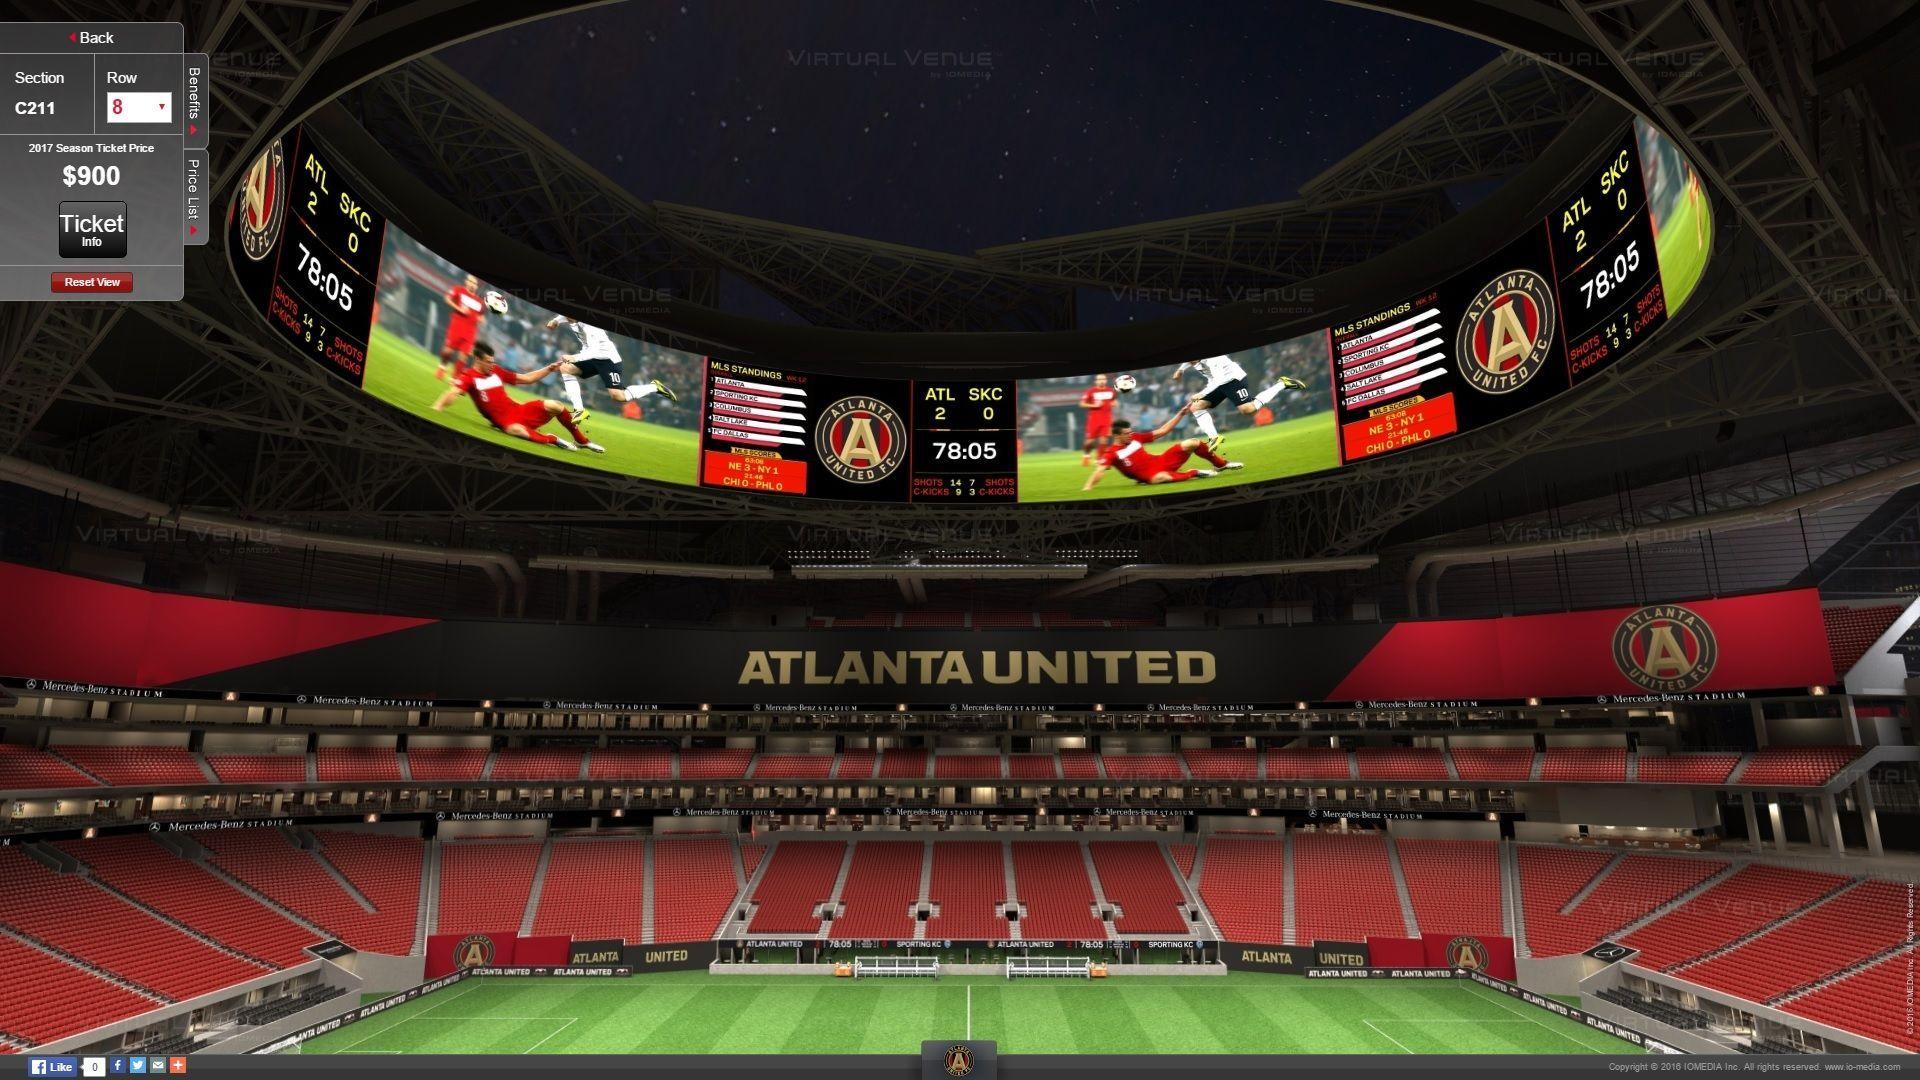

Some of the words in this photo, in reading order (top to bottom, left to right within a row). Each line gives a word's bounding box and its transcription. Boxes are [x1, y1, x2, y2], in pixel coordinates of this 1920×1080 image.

[305, 153, 328, 195] ATL
[339, 192, 372, 233] SKC
[1562, 197, 1592, 234] ATL
[1600, 150, 1630, 195] SKC
[308, 192, 318, 216] 2
[348, 232, 358, 253] 0
[1575, 230, 1587, 252] 2
[1618, 188, 1628, 211] 0
[298, 242, 354, 312] 78:05
[1580, 240, 1640, 309] 78:05
[1468, 275, 1534, 322] ATLANTA
[274, 285, 298, 315] SHOTS
[303, 313, 314, 328] 14
[334, 336, 364, 362] SHOTS
[1334, 324, 1354, 336] MLS
[1356, 302, 1411, 330] STANDINGS
[1570, 335, 1600, 362] SHOTS
[1606, 323, 1617, 338] 14
[1637, 284, 1661, 314] SHOTS
[272, 301, 301, 335] C-KICKS
[326, 346, 361, 375] C-KICKS
[1342, 335, 1373, 350] ATLANTA
[1572, 344, 1608, 374] C-KICKS
[1634, 300, 1664, 334] C-KICKS
[710, 361, 730, 372] MLS
[732, 366, 782, 380] STANDINGS
[1472, 366, 1530, 390] UNITED
[1531, 339, 1548, 364] FC
[608, 372, 620, 382] 10
[925, 388, 956, 401] ATL
[968, 387, 1002, 401] SKC
[1236, 388, 1249, 398] 10
[830, 400, 894, 422] ATLANTA
[934, 407, 946, 420] 2
[982, 407, 994, 420] 0
[1368, 425, 1384, 436] NE
[1400, 416, 1416, 426] NY
[932, 442, 997, 460] 78:05
[1366, 443, 1385, 454] CHI
[1402, 434, 1422, 446] PHL
[728, 462, 742, 471] NE
[758, 466, 772, 474] NY
[824, 456, 876, 480] UNITED
[880, 457, 896, 475] FC
[724, 476, 740, 486] CHI
[756, 480, 774, 490] PHL
[914, 478, 943, 486] SHOTS
[950, 478, 962, 486] 14
[985, 478, 1014, 486] SHOTS
[913, 488, 950, 496] C-KICKS
[978, 488, 1015, 496] C-KICKS
[1624, 606, 1696, 632] ATLANTA
[738, 650, 974, 684] ATLANTA
[982, 650, 1217, 684] UNITED
[1628, 668, 1690, 692] UNITED
[1689, 664, 1710, 683] FC
[42, 680, 108, 694] Mercedes-Benz
[110, 688, 163, 698] STADIUM
[313, 696, 381, 706] Mercedes-Benz
[384, 700, 433, 708] STADIUM
[556, 701, 613, 710] Mercedes-Benz
[1368, 700, 1428, 708] Mercedes-Benz
[1613, 694, 1685, 704] Mercedes-Benz
[1688, 692, 1746, 701] STADIUM
[1158, 703, 1210, 711] Mercedes-Benz
[452, 812, 513, 820] Mercedes-Benz
[686, 808, 739, 816] Mercedes-Benz
[896, 808, 948, 816] Mercedes-Benz
[1106, 808, 1158, 816] Mercedes-Benz
[1322, 810, 1381, 818] Mercedes-Benz
[168, 820, 244, 832] Mercedes-Benz
[247, 818, 293, 828] STADIUM
[746, 940, 776, 948] ATLANTA
[776, 940, 803, 948] UNITED
[829, 940, 852, 948] 78:05
[896, 940, 930, 948] SPORTING
[932, 940, 942, 948] KC
[572, 951, 618, 964] ATLANTA
[646, 950, 688, 964] UNITED
[1242, 950, 1292, 965] ATLANTA
[1320, 952, 1364, 967] UNITED
[472, 968, 502, 976] ATLANTA
[504, 968, 530, 976] UNITED
[554, 968, 584, 976] ATLANTA
[586, 968, 612, 976] UNITED
[1308, 970, 1340, 978] ATLANTA
[1341, 970, 1368, 978] UNITED
[1392, 970, 1423, 978] ATLANTA
[1424, 970, 1450, 978] UNITED
[422, 980, 443, 994] ATLANTA
[360, 1002, 385, 1018] ATLANTA
[386, 994, 406, 1009] UNITED
[1522, 992, 1546, 1008] ATLANTA
[1546, 1001, 1568, 1016] UNITED
[316, 1018, 340, 1034] UNITED
[1586, 1016, 1614, 1034] ATLANTA
[1616, 1028, 1641, 1044] UNITED
